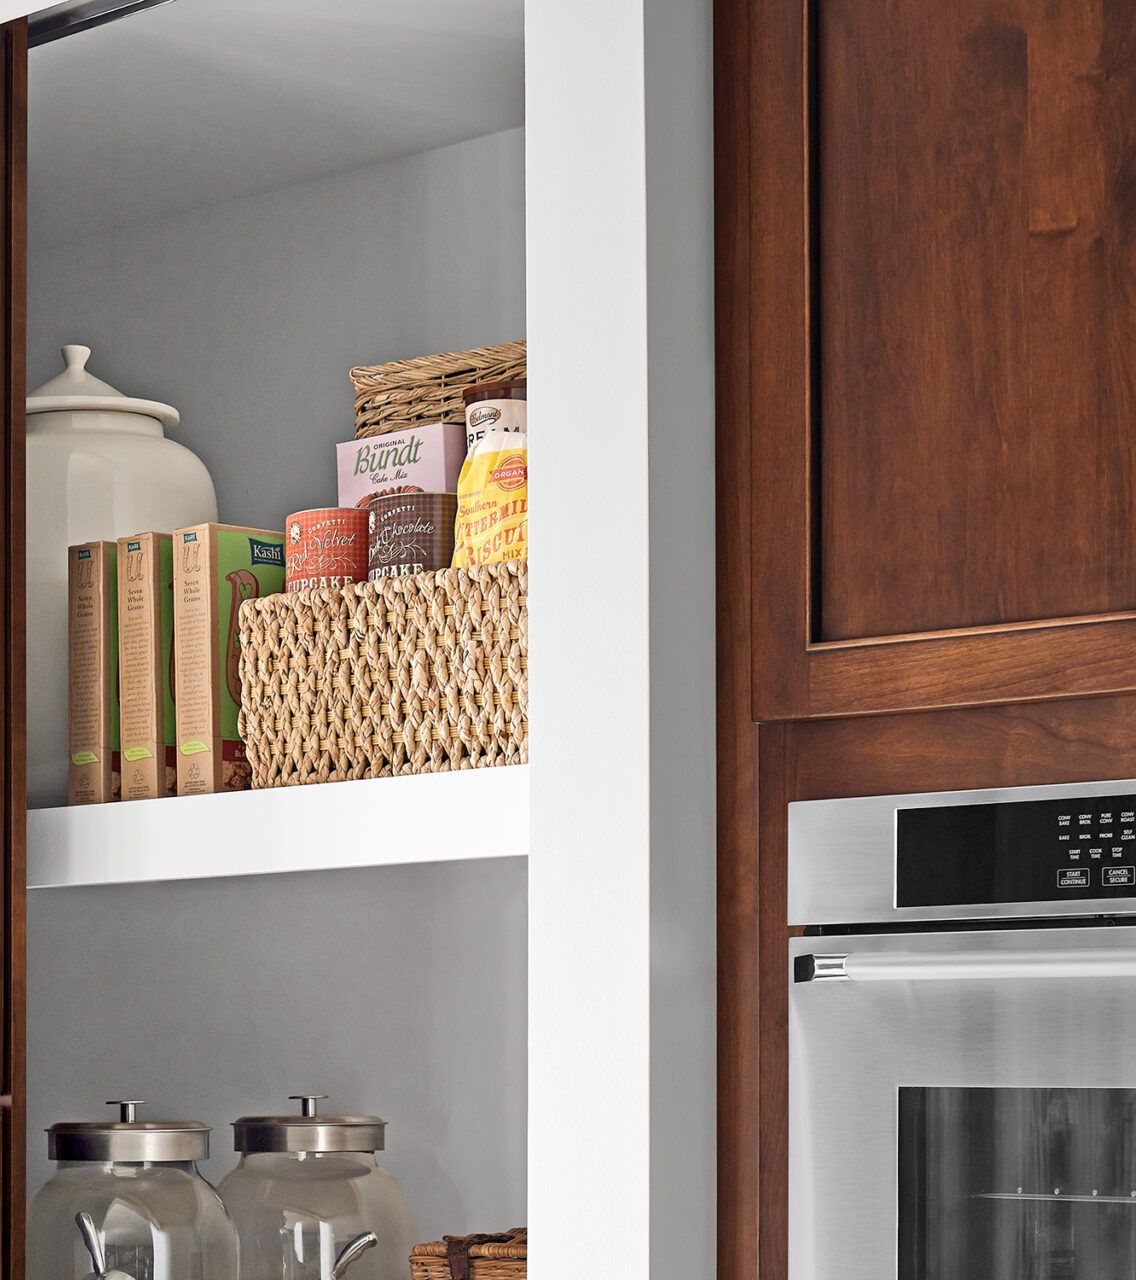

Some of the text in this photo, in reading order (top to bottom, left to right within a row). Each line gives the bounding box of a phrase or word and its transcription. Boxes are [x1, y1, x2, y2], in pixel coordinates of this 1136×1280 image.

[373, 438, 406, 450] ORIGINAL
[354, 435, 424, 477] Bundt
[369, 470, 409, 485] Cake Mix
[380, 505, 415, 522] CONFETTI
[459, 500, 497, 518] Southern
[308, 519, 346, 535] CONFETTI
[379, 516, 435, 545] Chocolate
[253, 544, 281, 560] Kashi
[287, 529, 357, 578] Red Velvet
[503, 548, 522, 560] MIX
[183, 587, 200, 595] Whole
[184, 579, 199, 587] Seven
[288, 576, 353, 593] CUPCAKE
[128, 588, 143, 596] Seven
[183, 595, 201, 603] Grains
